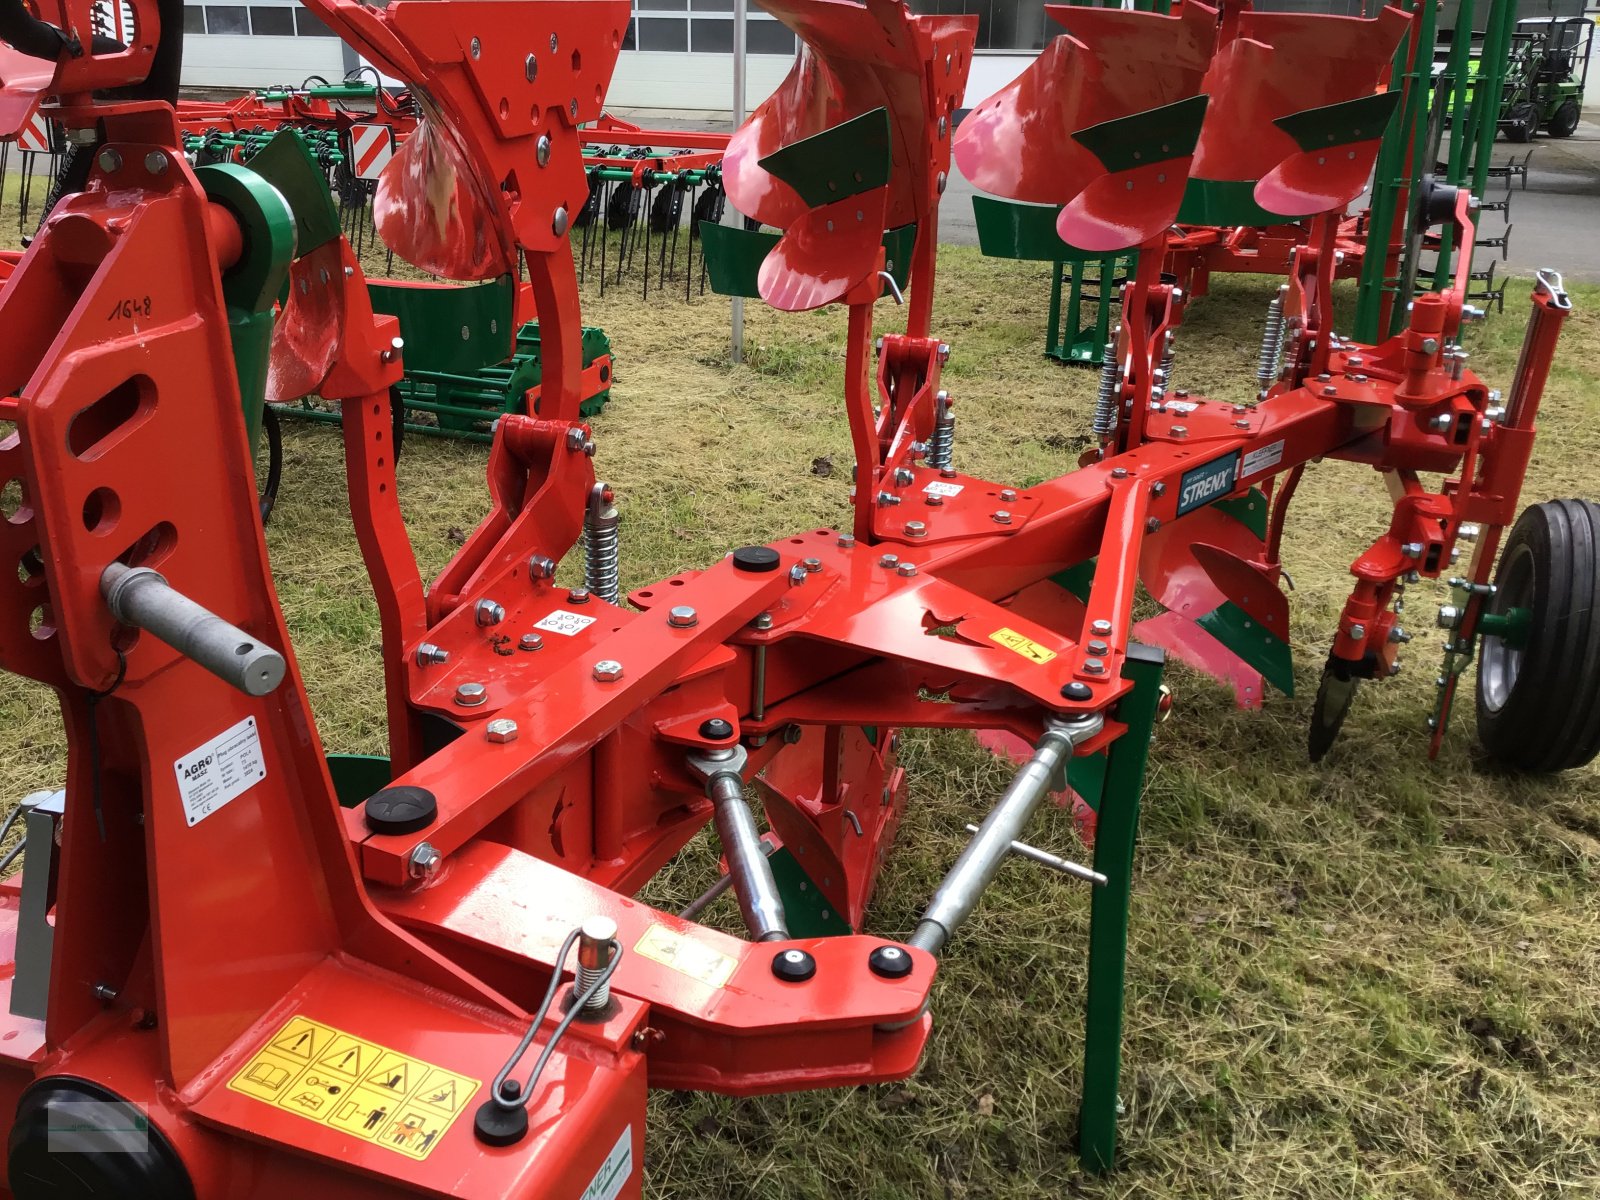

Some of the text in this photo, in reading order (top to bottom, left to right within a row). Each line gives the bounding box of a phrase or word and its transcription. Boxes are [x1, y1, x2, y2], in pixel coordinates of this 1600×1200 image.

[108, 295, 151, 321] 1648
[1180, 469, 1229, 507] STRENX
[184, 755, 212, 779] AGRO
[191, 768, 208, 781] MASZ
